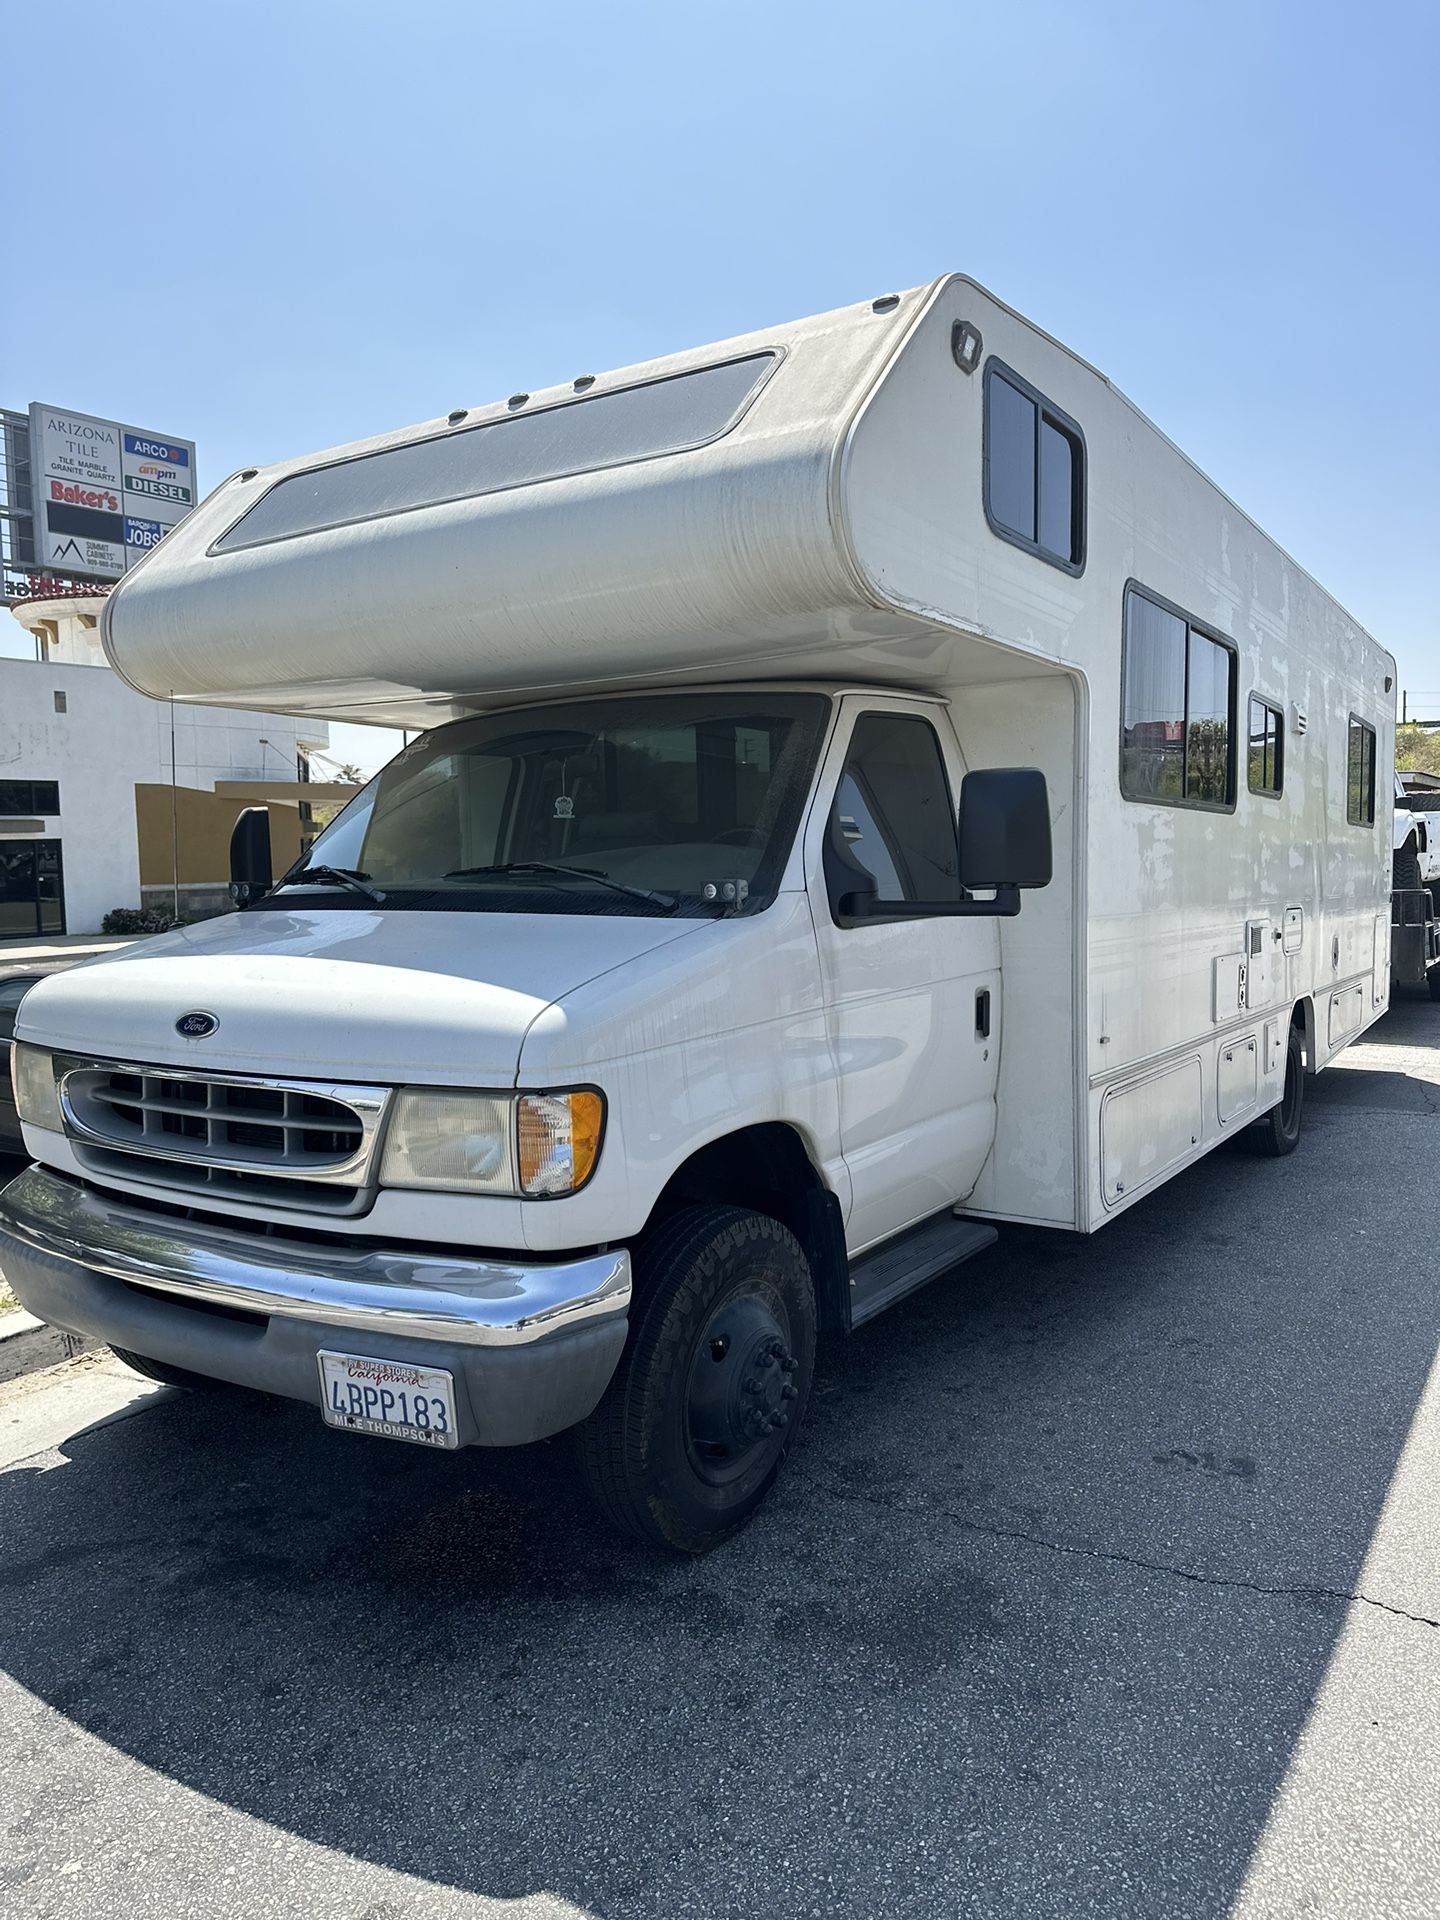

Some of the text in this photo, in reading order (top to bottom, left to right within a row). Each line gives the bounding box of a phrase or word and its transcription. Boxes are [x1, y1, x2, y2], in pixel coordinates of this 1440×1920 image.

[47, 419, 114, 445] ARIZONA
[65, 440, 99, 458] TILE
[134, 441, 168, 458] ARCO
[51, 462, 116, 482] GRANITE QUARTZ
[58, 456, 108, 473] TILE MARBLE
[138, 465, 176, 480] ampm
[51, 480, 118, 512] Baker's
[131, 478, 186, 500] DIESEL
[126, 528, 160, 546] JOBS
[183, 1016, 208, 1032] Ford
[347, 1367, 429, 1389] California
[359, 1361, 385, 1372] SUPER
[386, 1365, 416, 1378] STORES
[332, 1380, 448, 1434] 4BPP183
